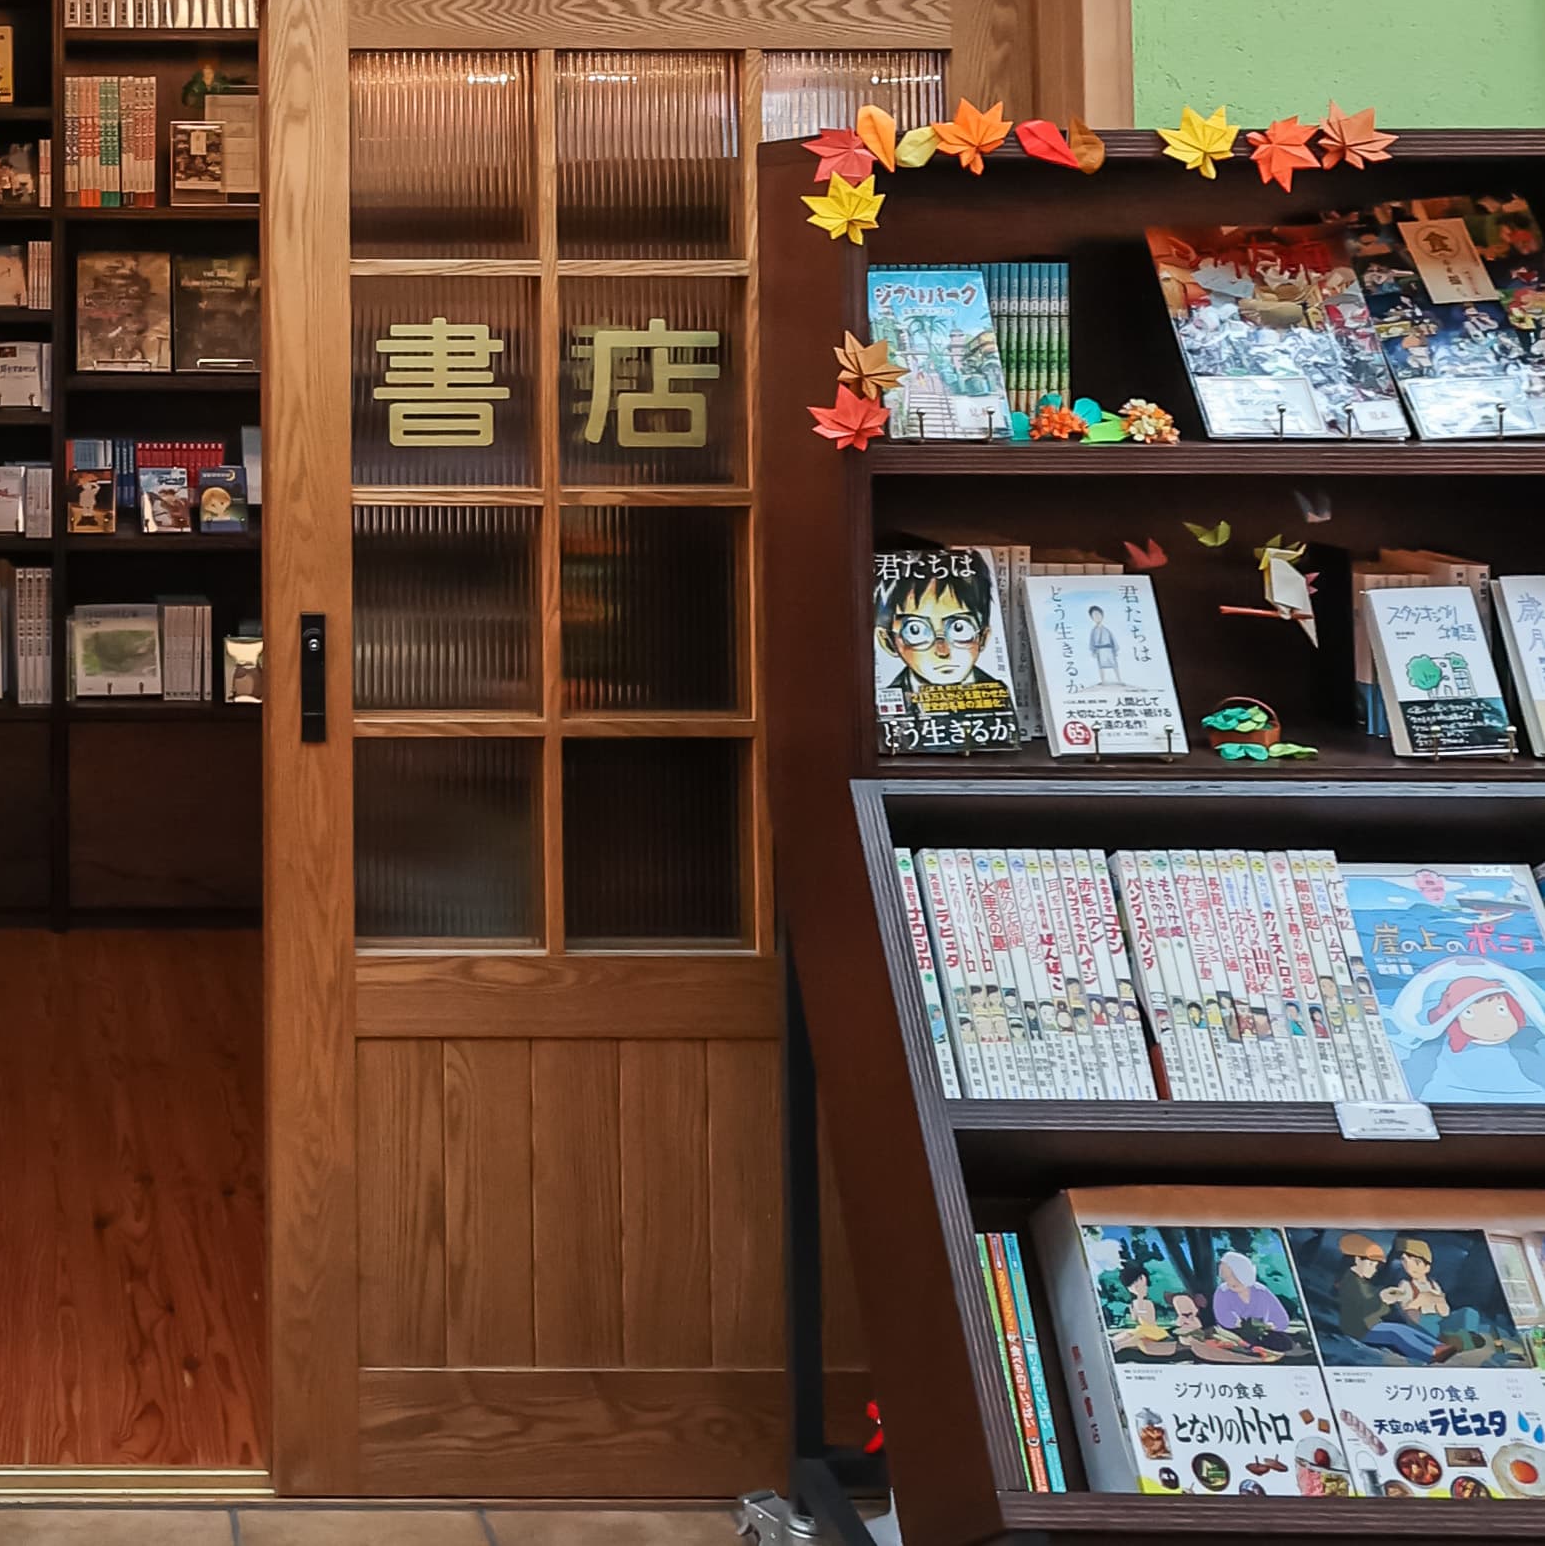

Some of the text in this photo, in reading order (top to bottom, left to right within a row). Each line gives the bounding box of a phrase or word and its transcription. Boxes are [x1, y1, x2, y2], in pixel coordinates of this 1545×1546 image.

[874, 283, 977, 305] ジブリパーク
[874, 553, 977, 581] 君たちは
[1118, 585, 1152, 662] 君たちは
[1050, 585, 1084, 694] どう生きるか
[1371, 921, 1536, 955] 崖の上のポニョ
[1173, 1382, 1268, 1399] ジブリの食卓
[1385, 1385, 1480, 1403] ジブリの食卓
[1172, 1406, 1295, 1446] となりのトトロ
[1373, 1407, 1508, 1438] 天空の城ラピュタ
